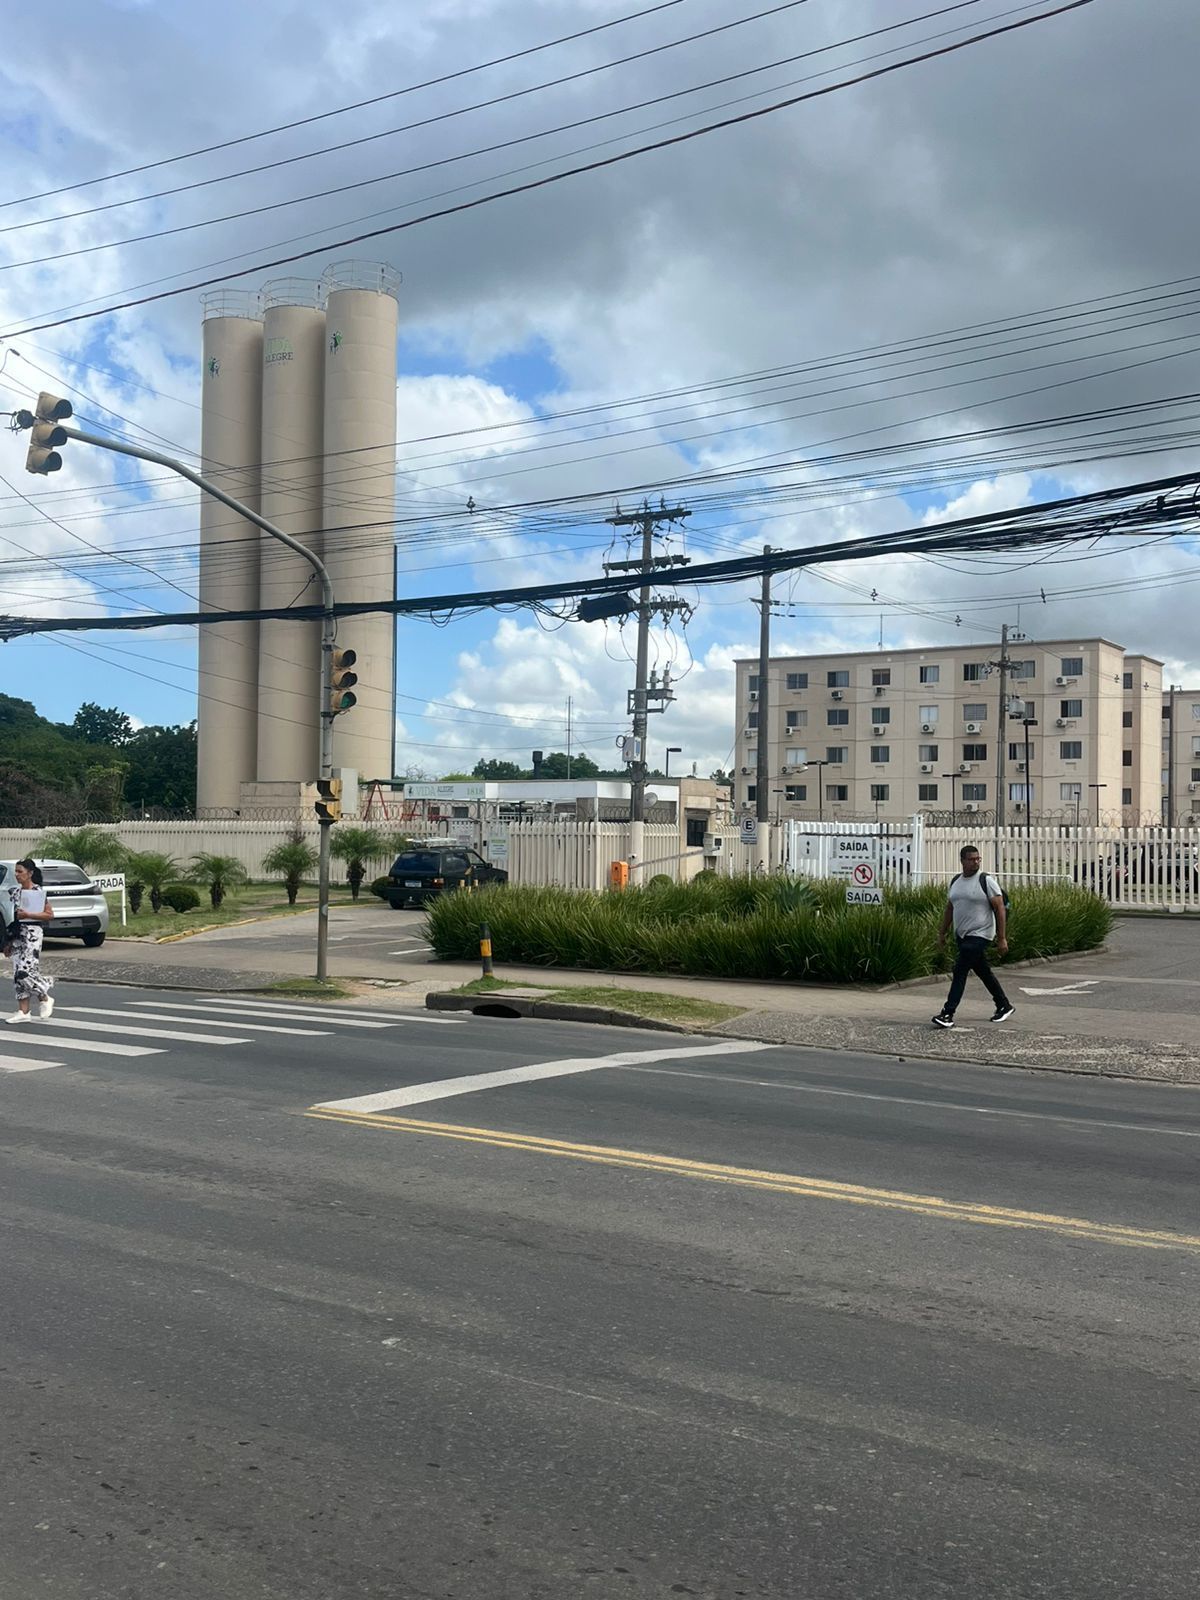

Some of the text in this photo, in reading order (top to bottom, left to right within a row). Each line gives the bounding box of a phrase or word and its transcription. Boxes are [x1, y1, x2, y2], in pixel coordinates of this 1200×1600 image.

[745, 820, 752, 830] E
[839, 840, 869, 851] SAÍDA
[847, 890, 880, 903] SAÍDA
